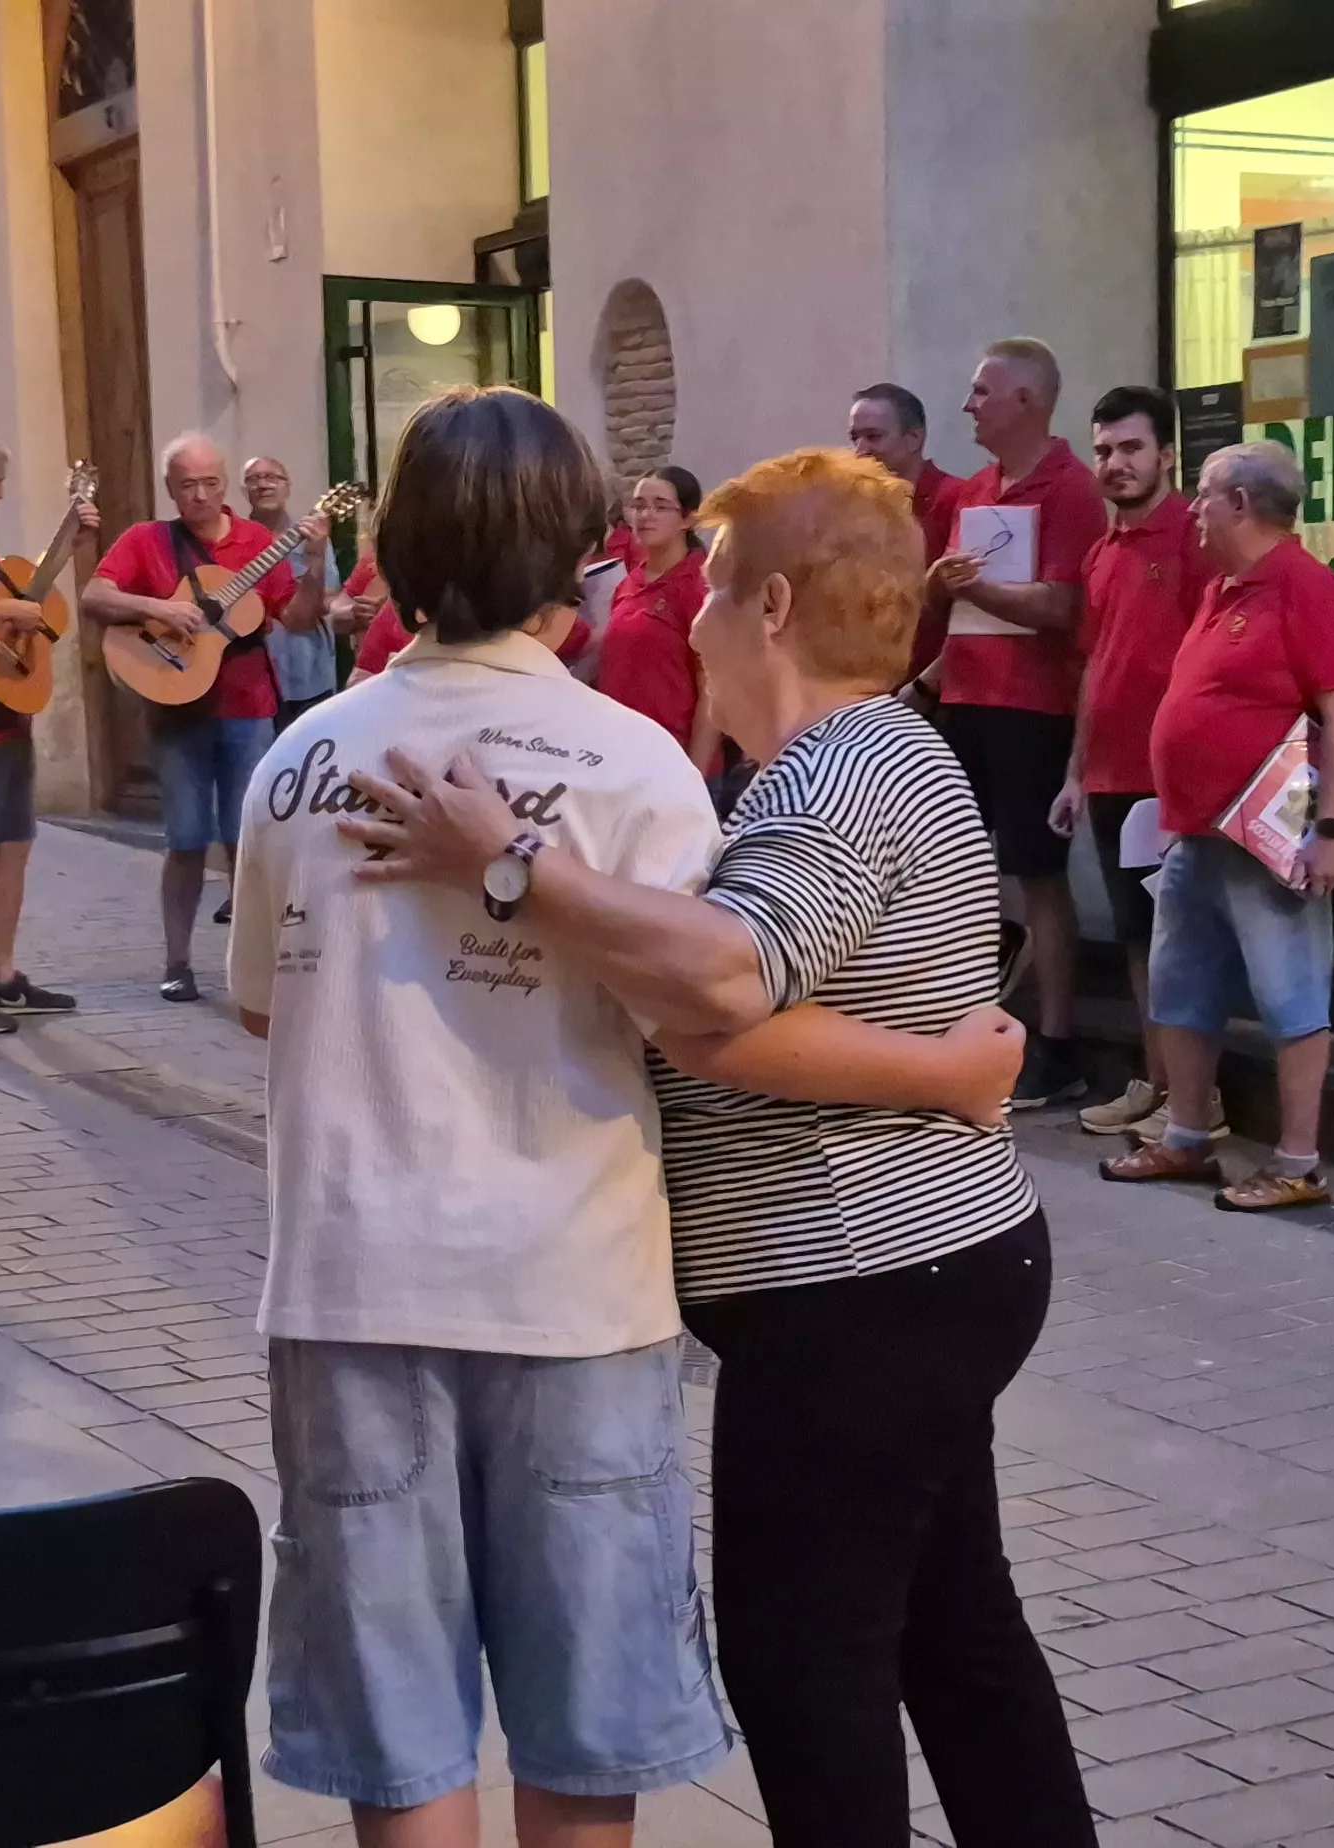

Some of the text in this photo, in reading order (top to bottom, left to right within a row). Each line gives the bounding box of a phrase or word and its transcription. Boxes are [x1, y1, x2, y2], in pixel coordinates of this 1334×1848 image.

[477, 728, 524, 748] Worn
[577, 749, 604, 767] '79
[508, 941, 543, 967] for
[446, 959, 542, 996] Everyday
